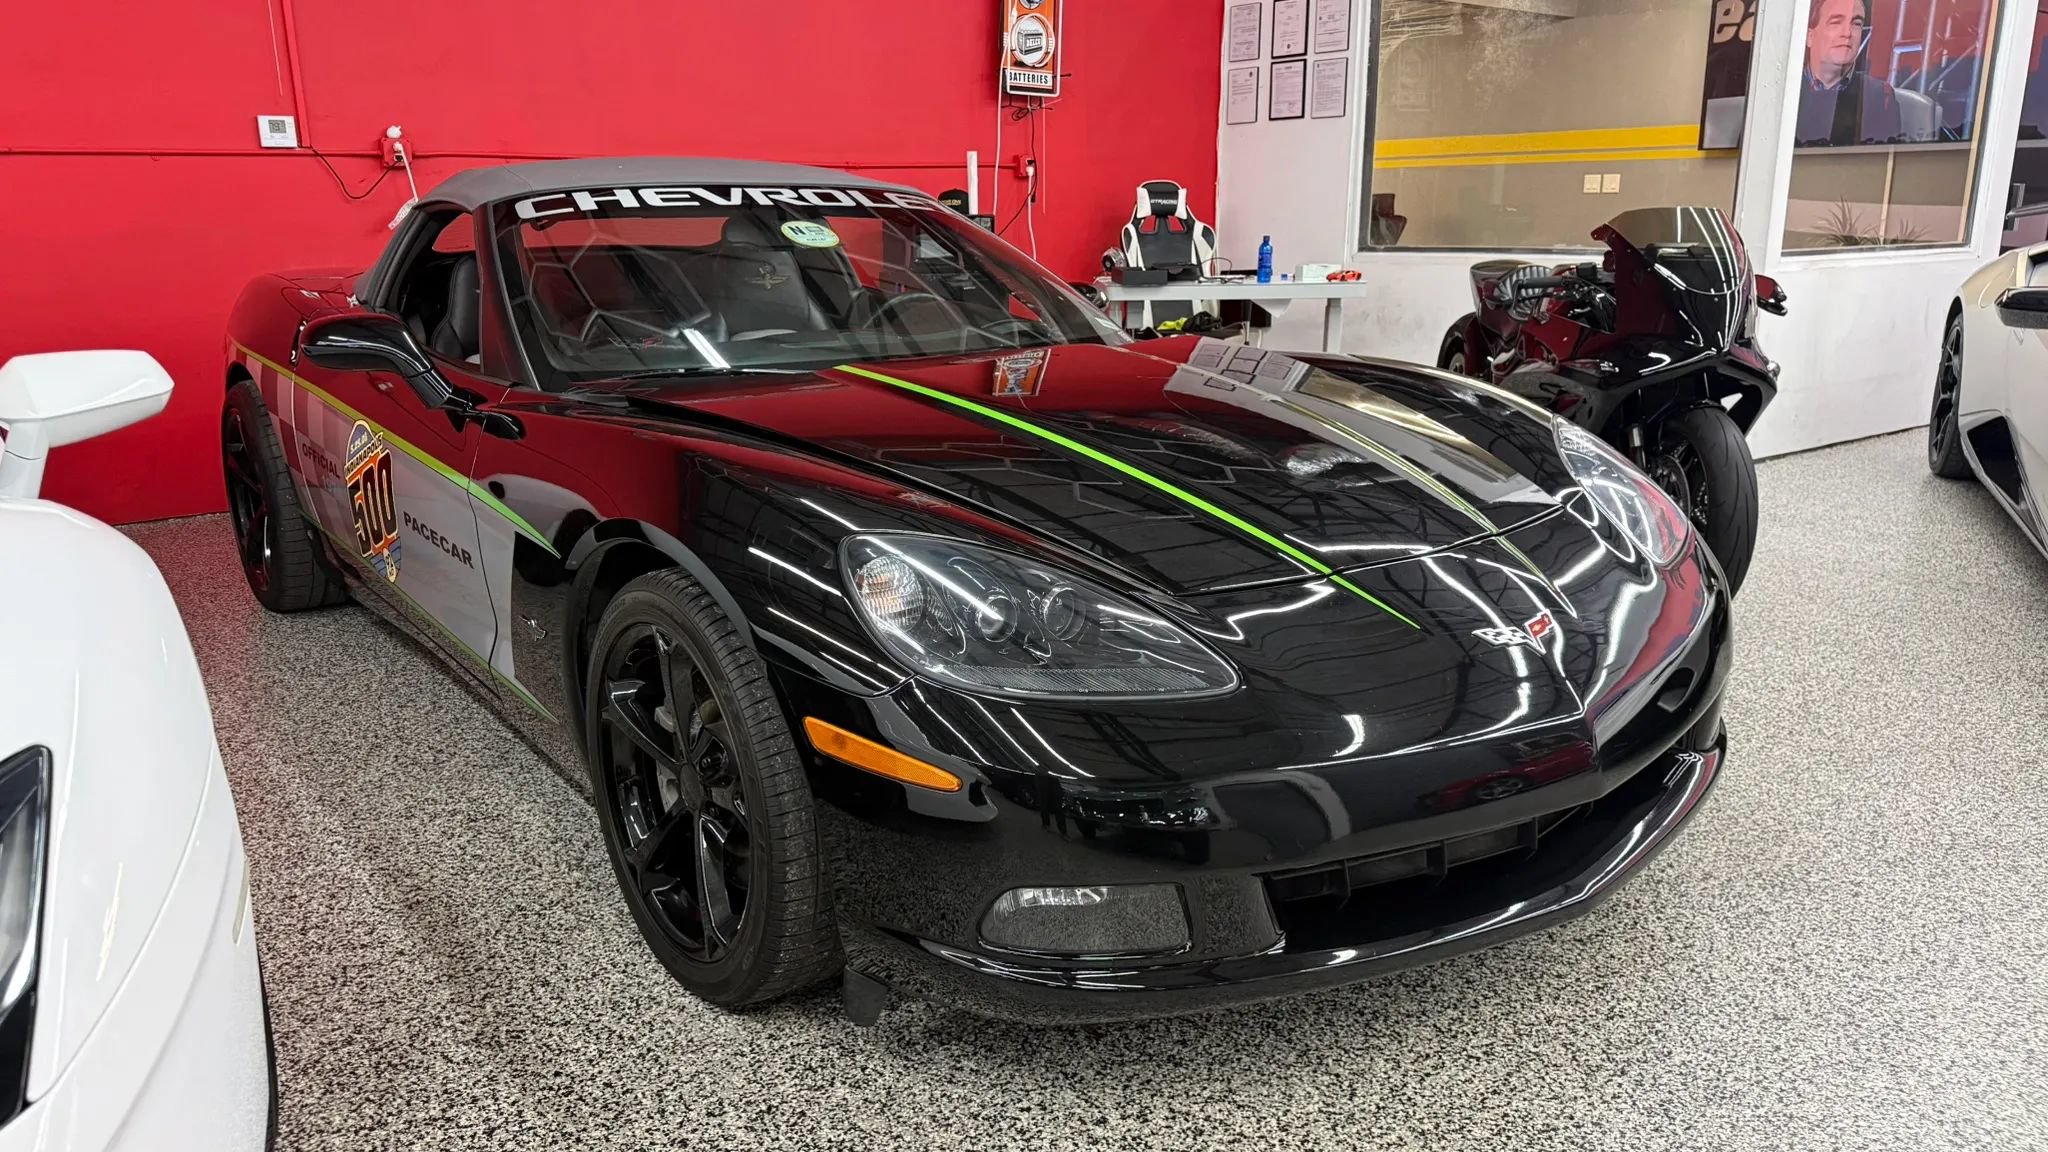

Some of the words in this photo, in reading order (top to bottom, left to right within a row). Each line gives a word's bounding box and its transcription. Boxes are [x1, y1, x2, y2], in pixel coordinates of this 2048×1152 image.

[1008, 71, 1049, 85] BATTERIES
[515, 187, 942, 219] CHEVROLE
[302, 443, 341, 478] OFFICIAL
[345, 432, 384, 476] INDIANAPOLIS
[347, 450, 398, 557] 500
[403, 511, 475, 569] PACECAR
